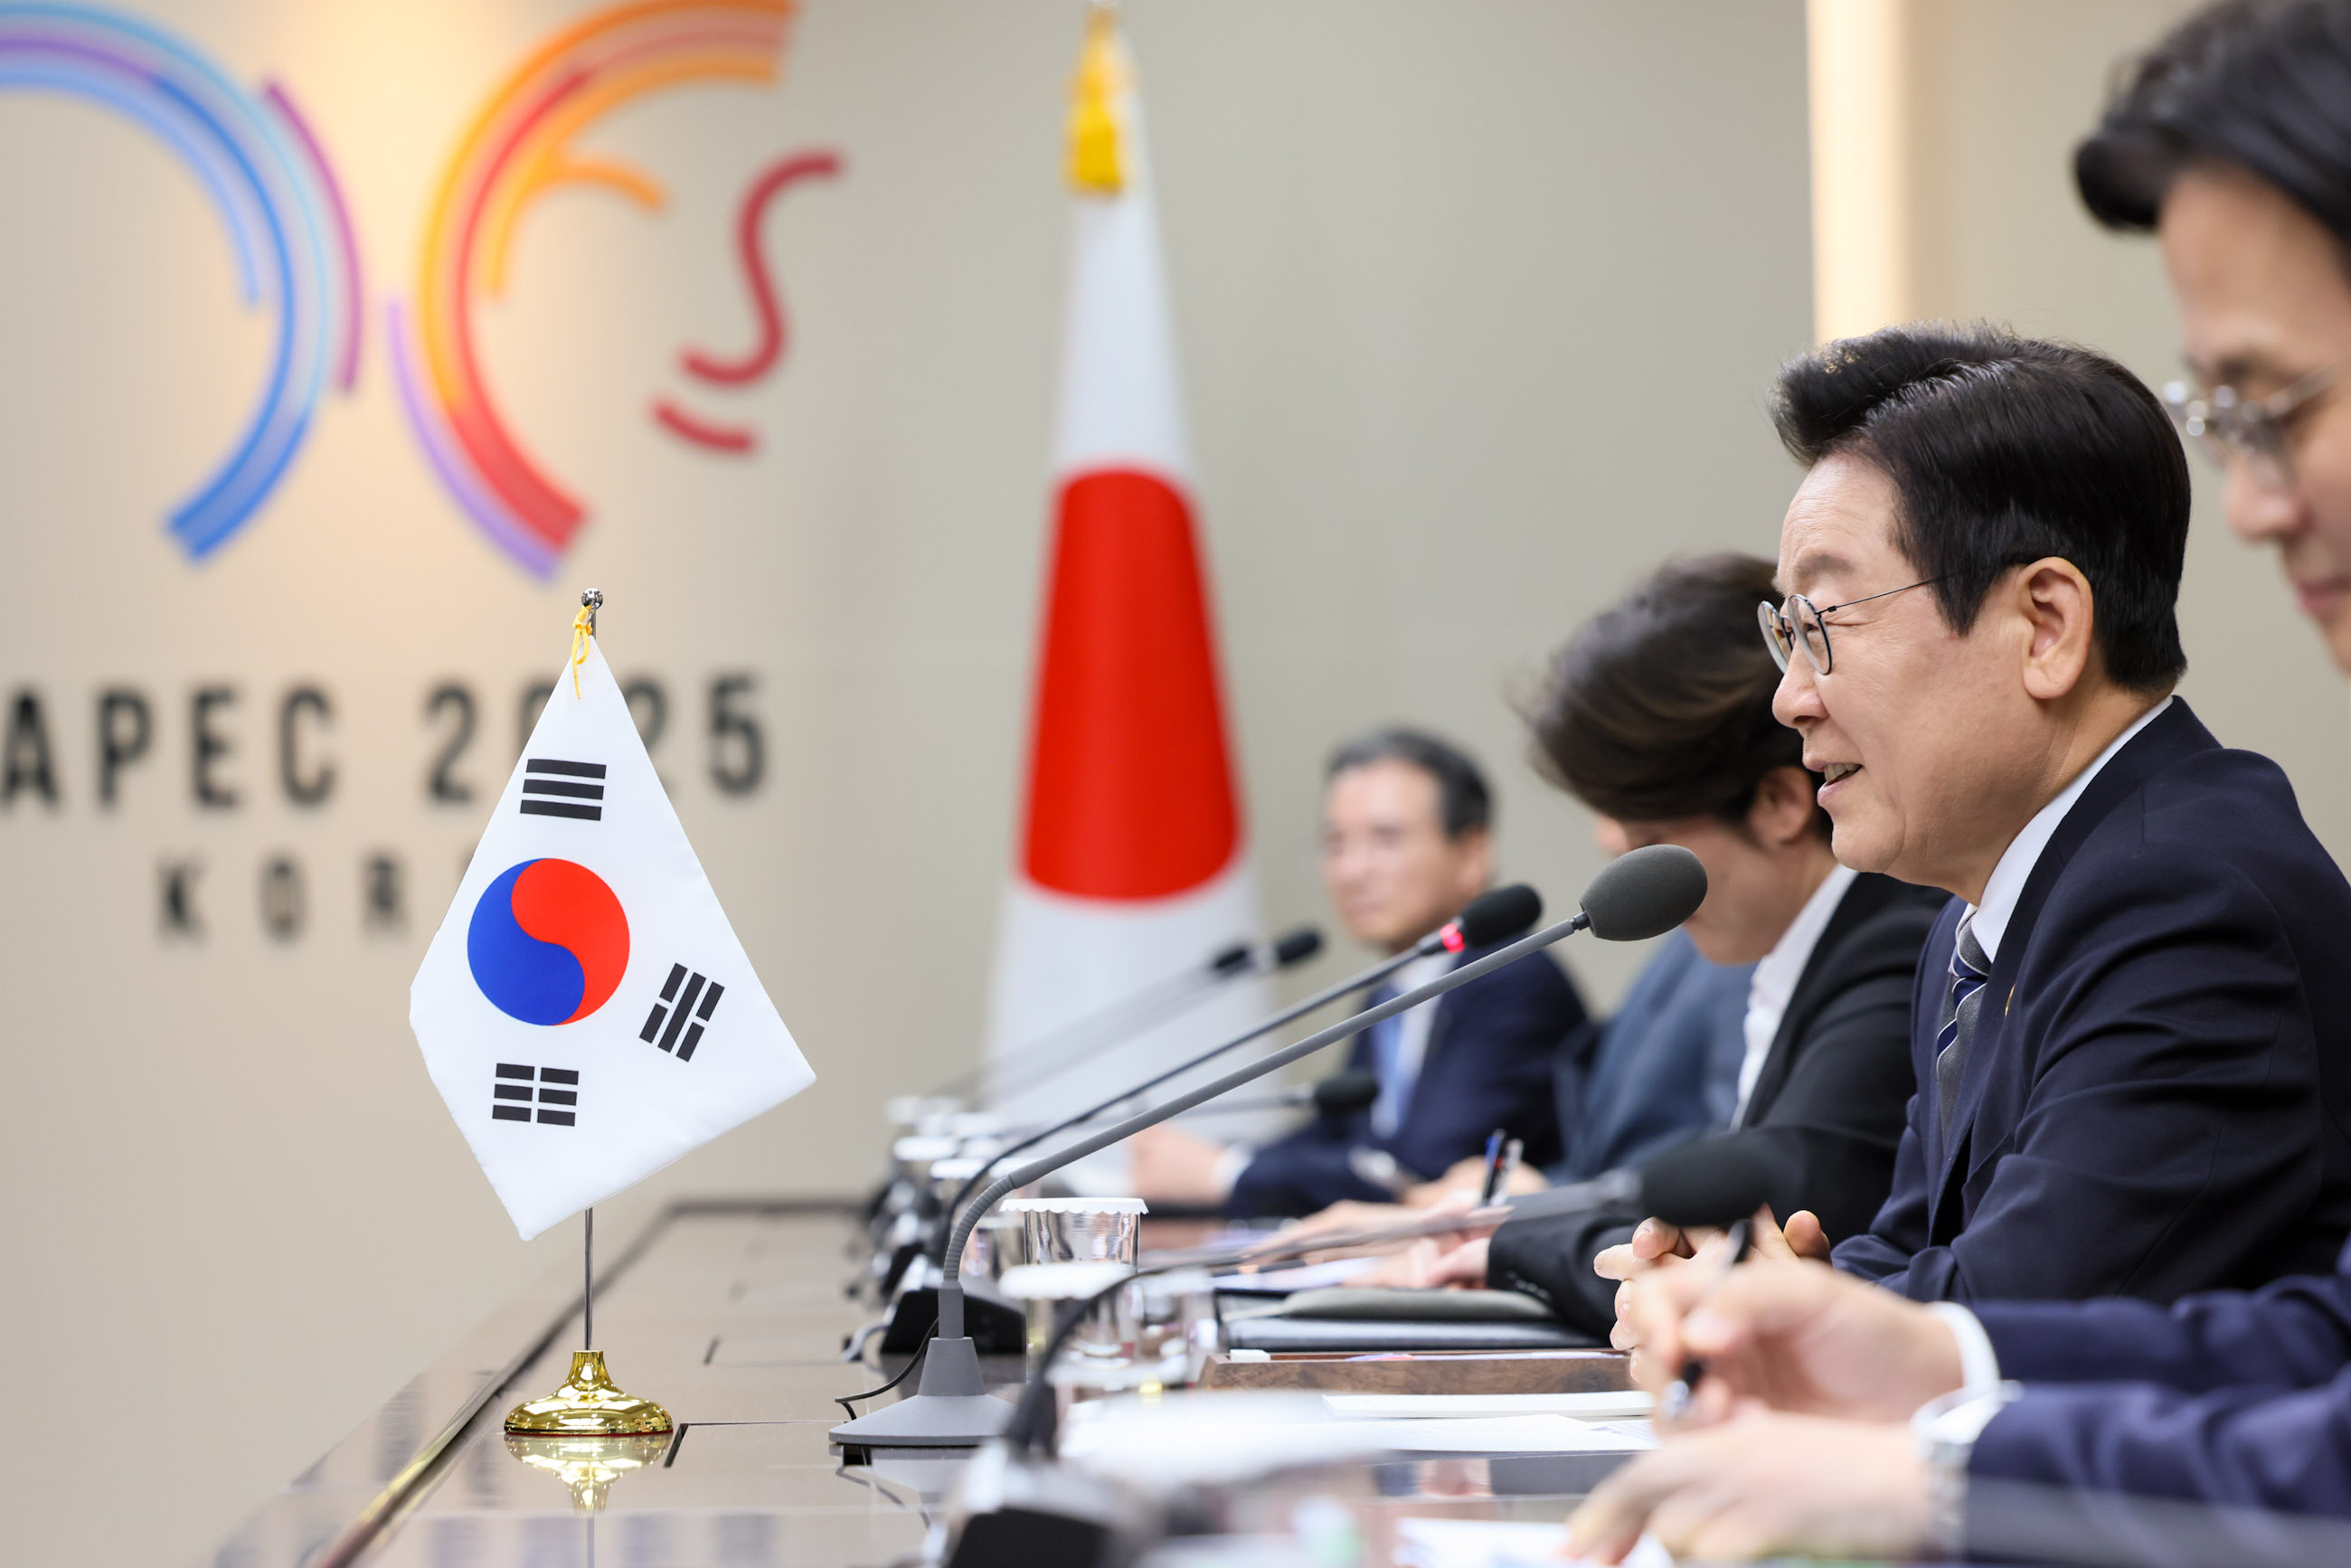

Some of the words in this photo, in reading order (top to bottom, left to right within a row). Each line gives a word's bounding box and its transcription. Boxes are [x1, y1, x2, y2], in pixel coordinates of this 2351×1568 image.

[0, 684, 335, 812] APEC
[425, 673, 769, 805] 225
[158, 854, 476, 939] KOR
